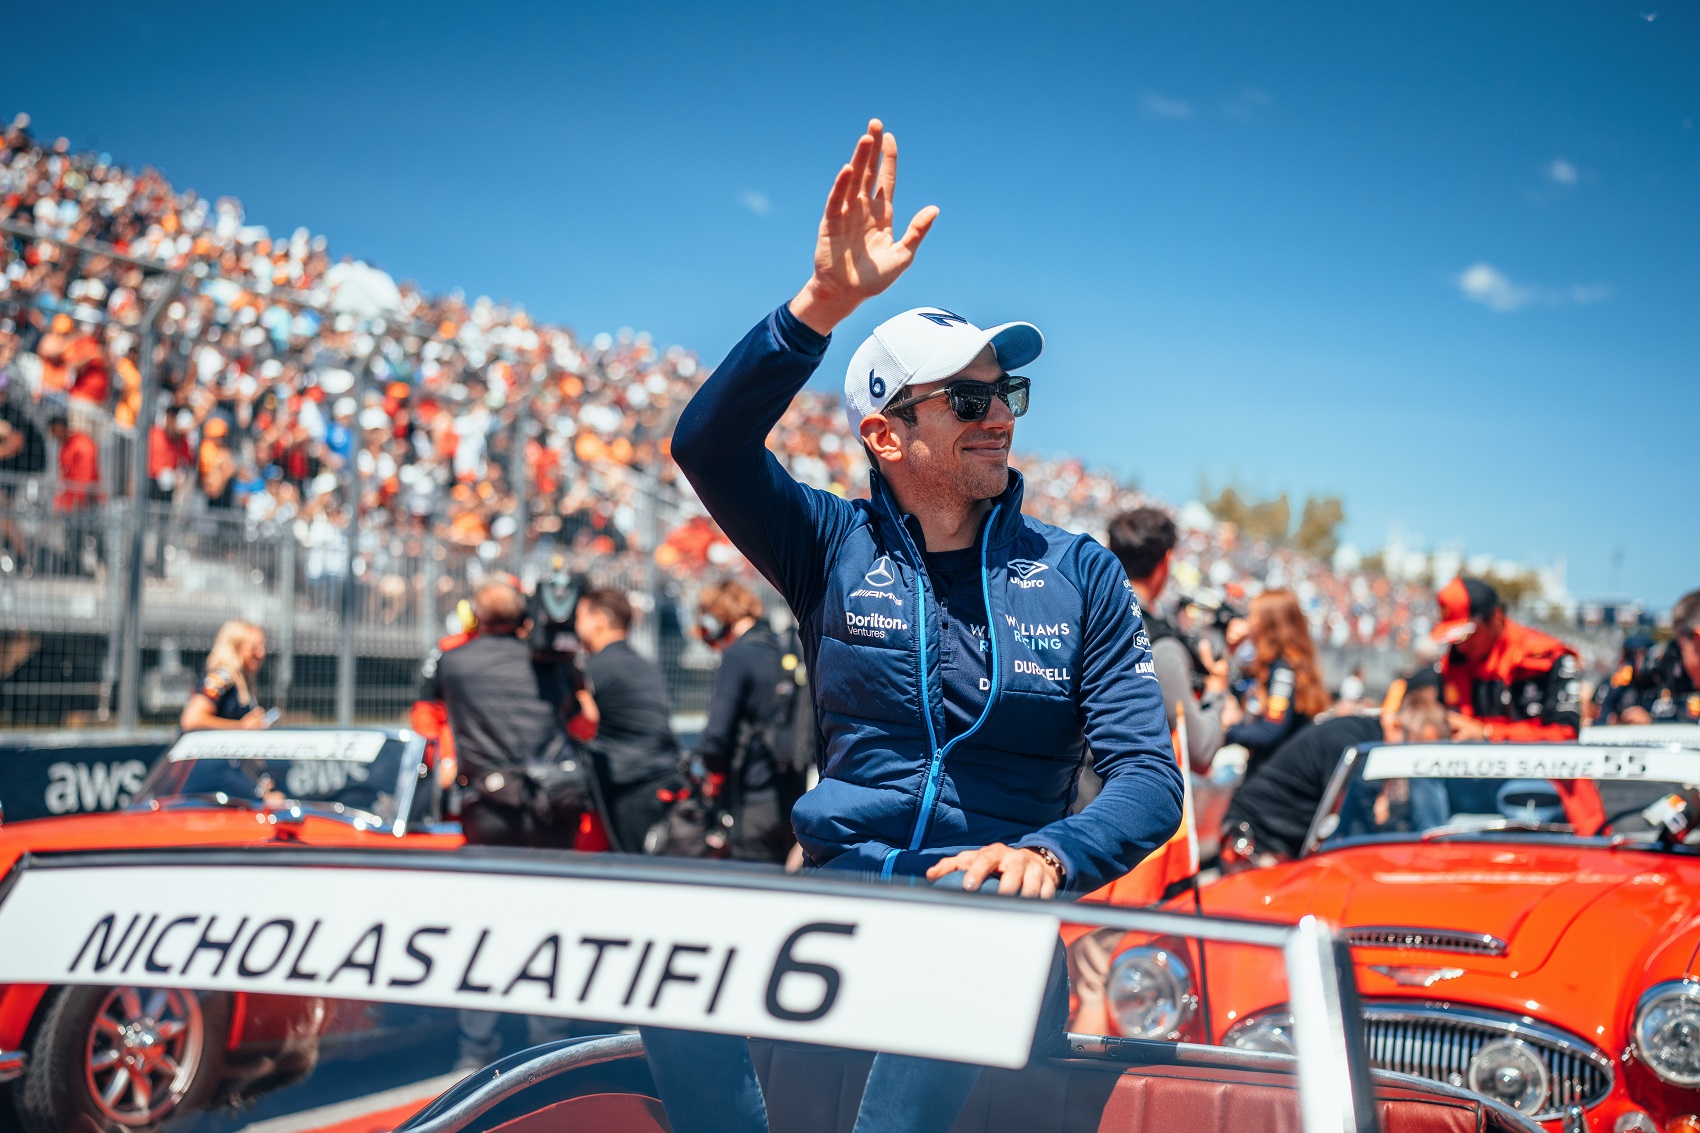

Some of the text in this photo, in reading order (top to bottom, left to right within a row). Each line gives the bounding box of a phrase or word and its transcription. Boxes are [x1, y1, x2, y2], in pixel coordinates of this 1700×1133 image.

[868, 368, 887, 399] 6
[846, 625, 886, 639] Ventures
[1412, 758, 1508, 777] CARLOS
[1603, 751, 1647, 778] 55
[44, 759, 148, 815] aws
[68, 913, 859, 1023] NICHOLAS LATIFI 6
